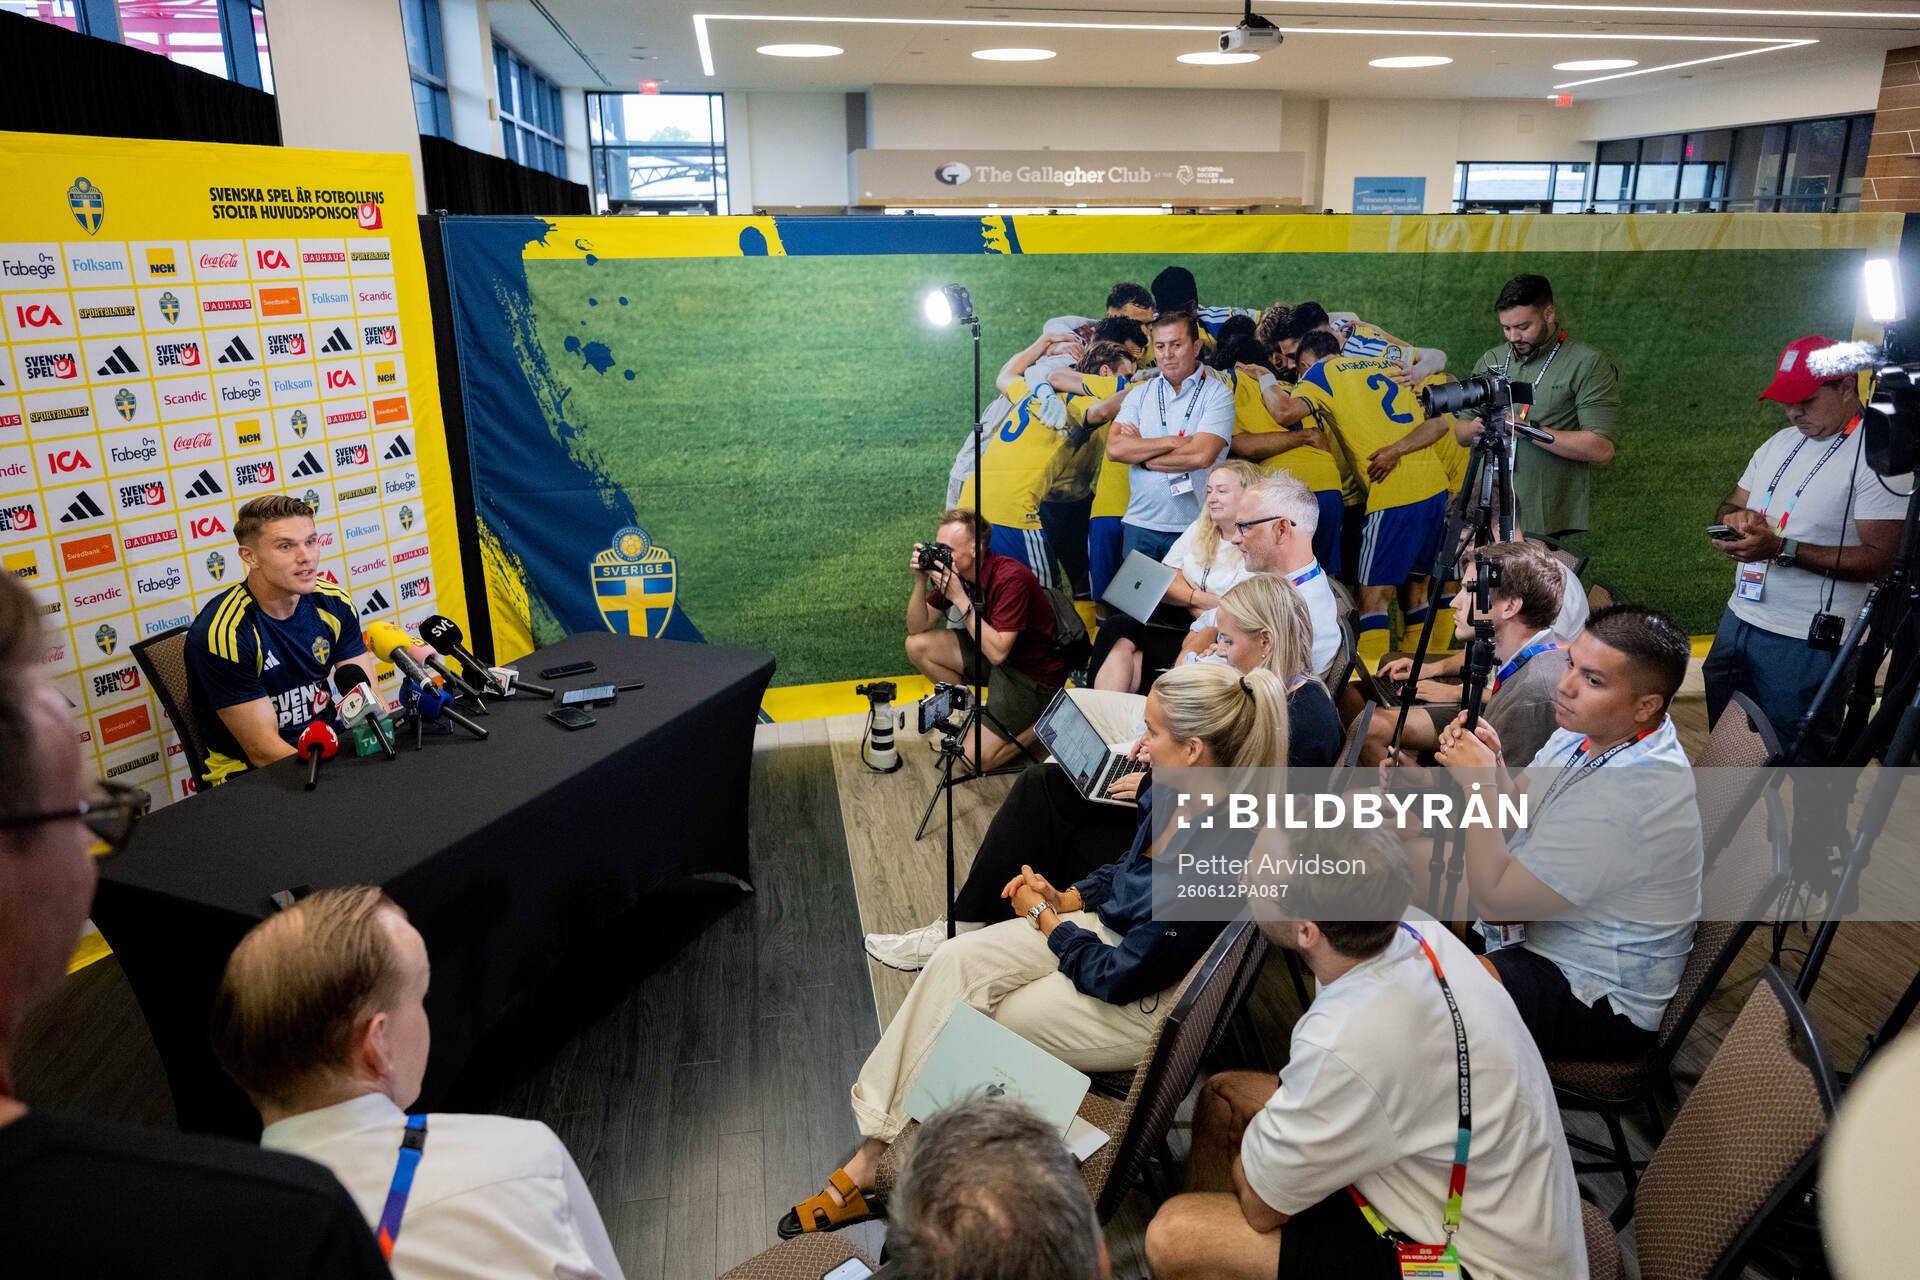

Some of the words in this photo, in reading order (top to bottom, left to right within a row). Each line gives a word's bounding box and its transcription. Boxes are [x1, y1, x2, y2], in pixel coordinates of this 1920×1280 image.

[975, 166, 1013, 182] The
[1017, 165, 1106, 187] Gallagher
[1108, 166, 1151, 183] Club
[209, 187, 263, 203] SVENSKA
[268, 189, 295, 203] SPEL
[297, 186, 312, 203] ÄR
[316, 190, 385, 204] FOTBOLLENS
[212, 204, 258, 219] STOLTA
[261, 206, 359, 220] HUVUDSPONSOR
[72, 258, 124, 271] Folksam
[257, 250, 291, 269] ICA
[303, 253, 345, 263] BAUHAUS
[3, 260, 56, 279] Fabege
[312, 293, 348, 304] Folksam
[359, 291, 392, 302] Scandic
[79, 305, 136, 319] SPORTBLADET
[203, 299, 251, 312] BAUHAUS
[16, 305, 63, 328] ICA
[366, 335, 382, 345] SPEL
[270, 344, 289, 355] SPEL
[158, 354, 181, 366] SPEL
[27, 367, 54, 379] SPEL
[326, 370, 356, 389] ICA
[222, 384, 261, 401] Fabege
[274, 379, 312, 392] Folksam
[164, 390, 207, 405] Scandic
[1367, 373, 1414, 424] 2
[30, 406, 89, 423] SPORTBLADET
[327, 411, 366, 424] BAUHAUS
[48, 449, 92, 474] ICA
[111, 446, 157, 462] Fabege
[337, 455, 354, 466] SPEL
[0, 463, 28, 478] ndic
[238, 473, 257, 486] SPEL
[386, 480, 416, 494] Fabege
[122, 495, 146, 508] SPEL
[190, 516, 226, 540] ICA
[346, 524, 380, 539] Folksam
[125, 530, 178, 549] BAUHAUS
[393, 547, 429, 563] BAUHAUS
[351, 559, 386, 576] Scandic
[603, 564, 663, 576] SVERIGE
[137, 575, 181, 594] Fabege
[74, 587, 122, 608] Scandic
[402, 589, 417, 600] SPEL
[145, 615, 191, 634] Folksam
[95, 684, 120, 697] SPEL
[279, 704, 312, 728] PEL
[1569, 767, 1592, 786] WORLD
[1590, 756, 1605, 769] CUP
[1452, 1012, 1466, 1052] WORLD
[1459, 1053, 1468, 1076] CUP
